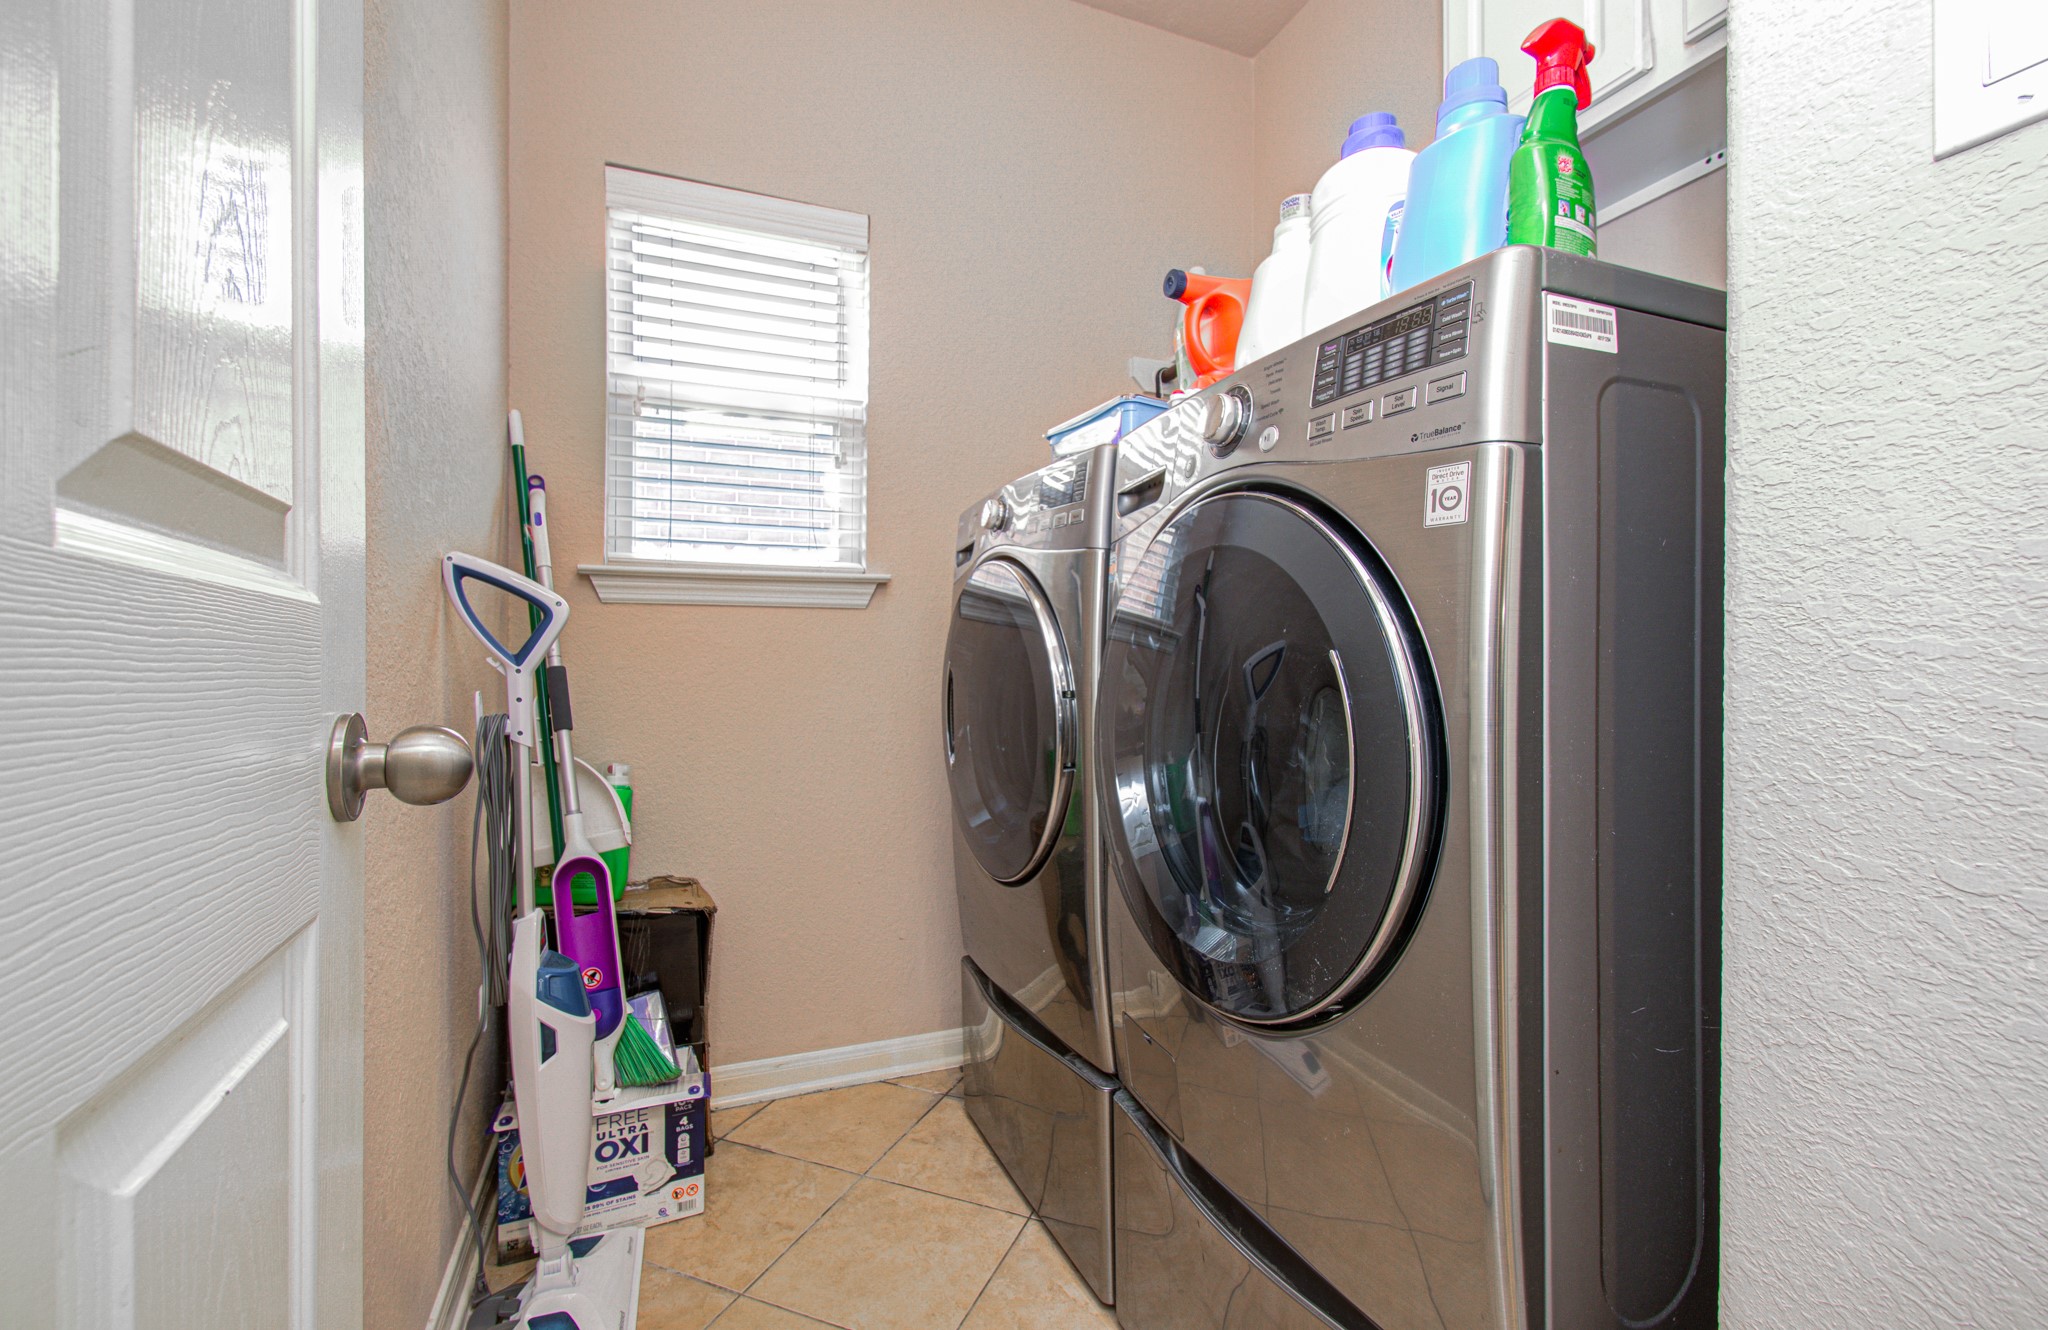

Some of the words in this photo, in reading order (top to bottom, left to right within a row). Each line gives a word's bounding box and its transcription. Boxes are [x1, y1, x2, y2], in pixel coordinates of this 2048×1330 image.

[1436, 383, 1454, 393] Signal
[1394, 394, 1404, 402] Soil
[1392, 401, 1406, 410] Level
[1353, 408, 1363, 416] Spin
[1350, 413, 1364, 423] Speed
[1432, 472, 1449, 481] Direct
[1449, 470, 1465, 478] Drive
[1431, 485, 1463, 514] 10
[1430, 514, 1461, 523] WARRANTY
[675, 1104, 693, 1112] PACS
[596, 1108, 648, 1131] FREE
[679, 1116, 689, 1126] 4
[596, 1123, 649, 1141] ULTRA
[676, 1124, 693, 1132] BAGS
[595, 1132, 649, 1163] OXI
[610, 1158, 637, 1168] SENSITIVE
[615, 1194, 637, 1203] STAINS
